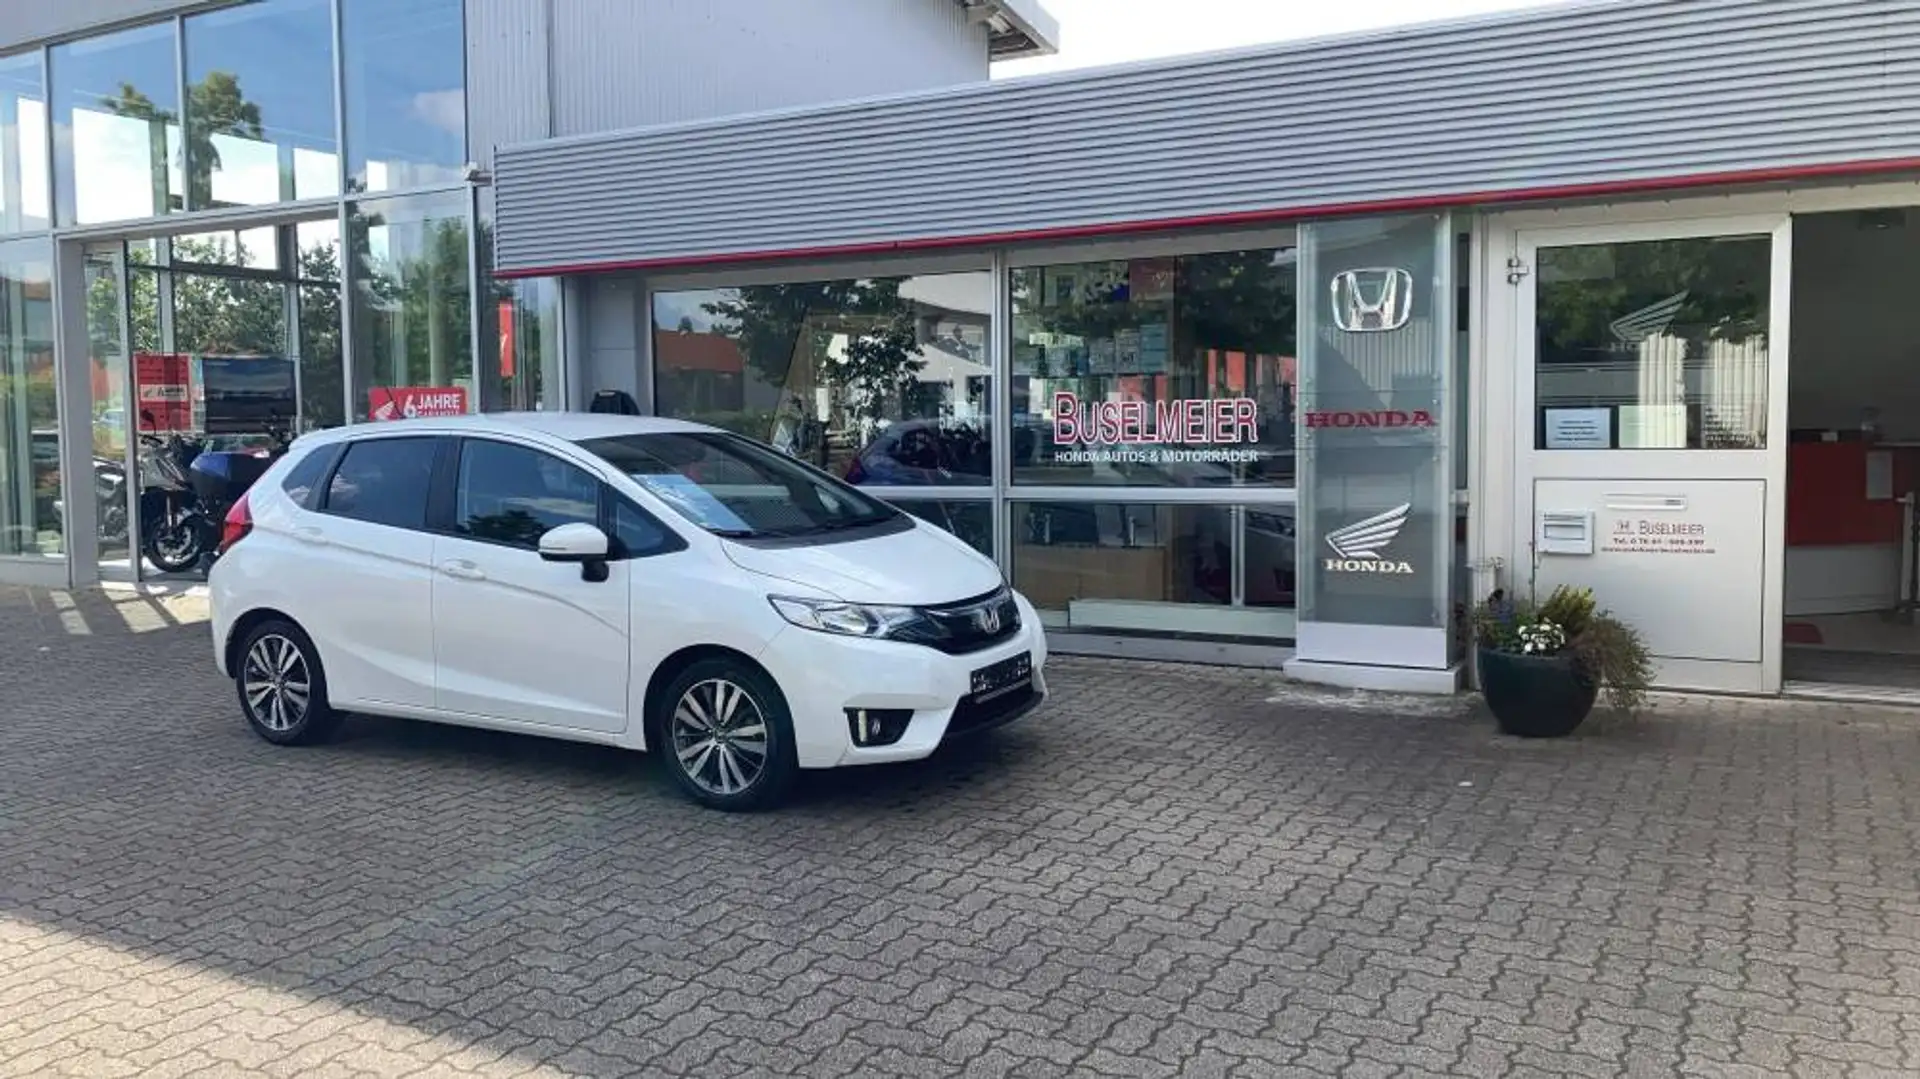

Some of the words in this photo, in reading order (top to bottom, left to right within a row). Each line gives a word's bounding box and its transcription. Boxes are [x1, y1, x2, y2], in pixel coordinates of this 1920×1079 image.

[403, 394, 417, 418] 6
[417, 393, 461, 409] JAHRE
[1054, 391, 1258, 445] BUSELMEIER
[1306, 410, 1436, 428] HONDA
[1055, 451, 1099, 462] HONDA
[1102, 451, 1146, 462] AUTOS
[1149, 451, 1159, 462] &
[1325, 559, 1414, 573] HONDA
